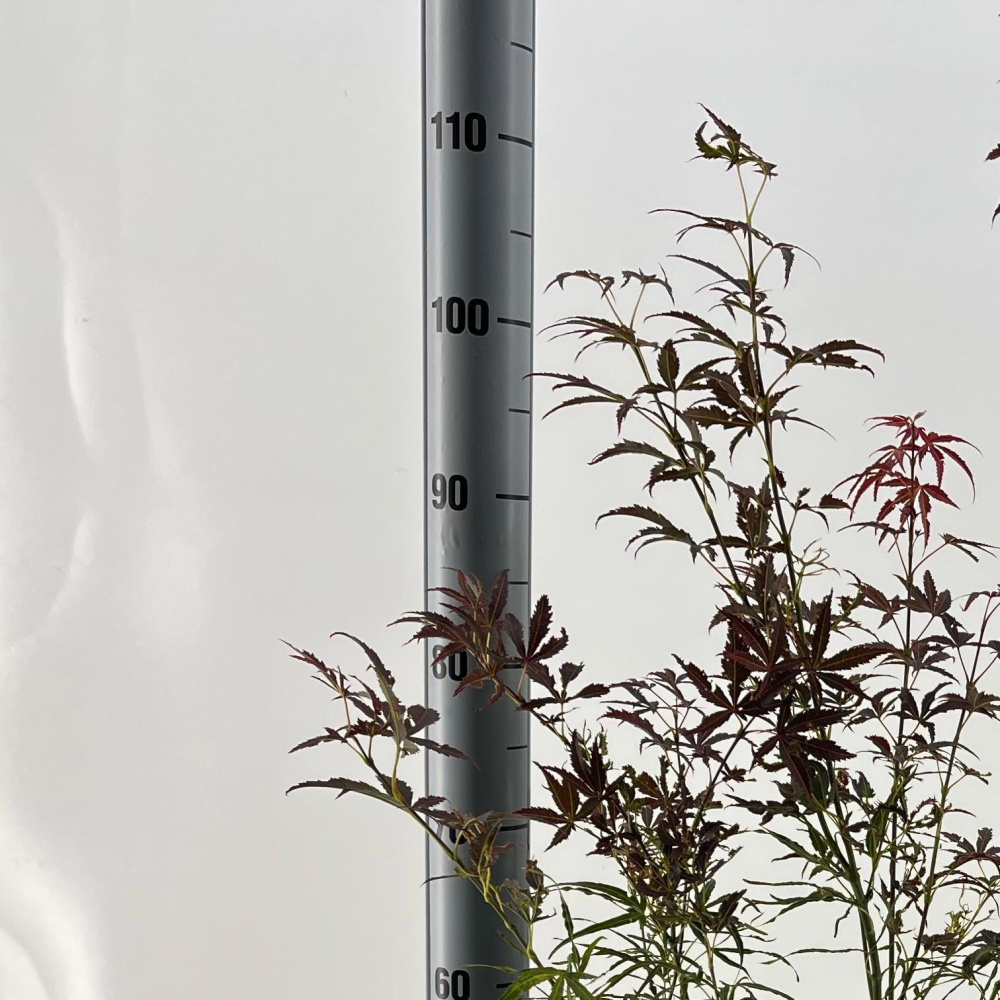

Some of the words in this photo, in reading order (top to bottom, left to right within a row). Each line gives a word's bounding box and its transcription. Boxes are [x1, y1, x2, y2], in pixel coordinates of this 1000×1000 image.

[431, 111, 487, 152] 110
[432, 296, 489, 336] 100
[432, 473, 468, 511] 90
[432, 645, 468, 682] 80
